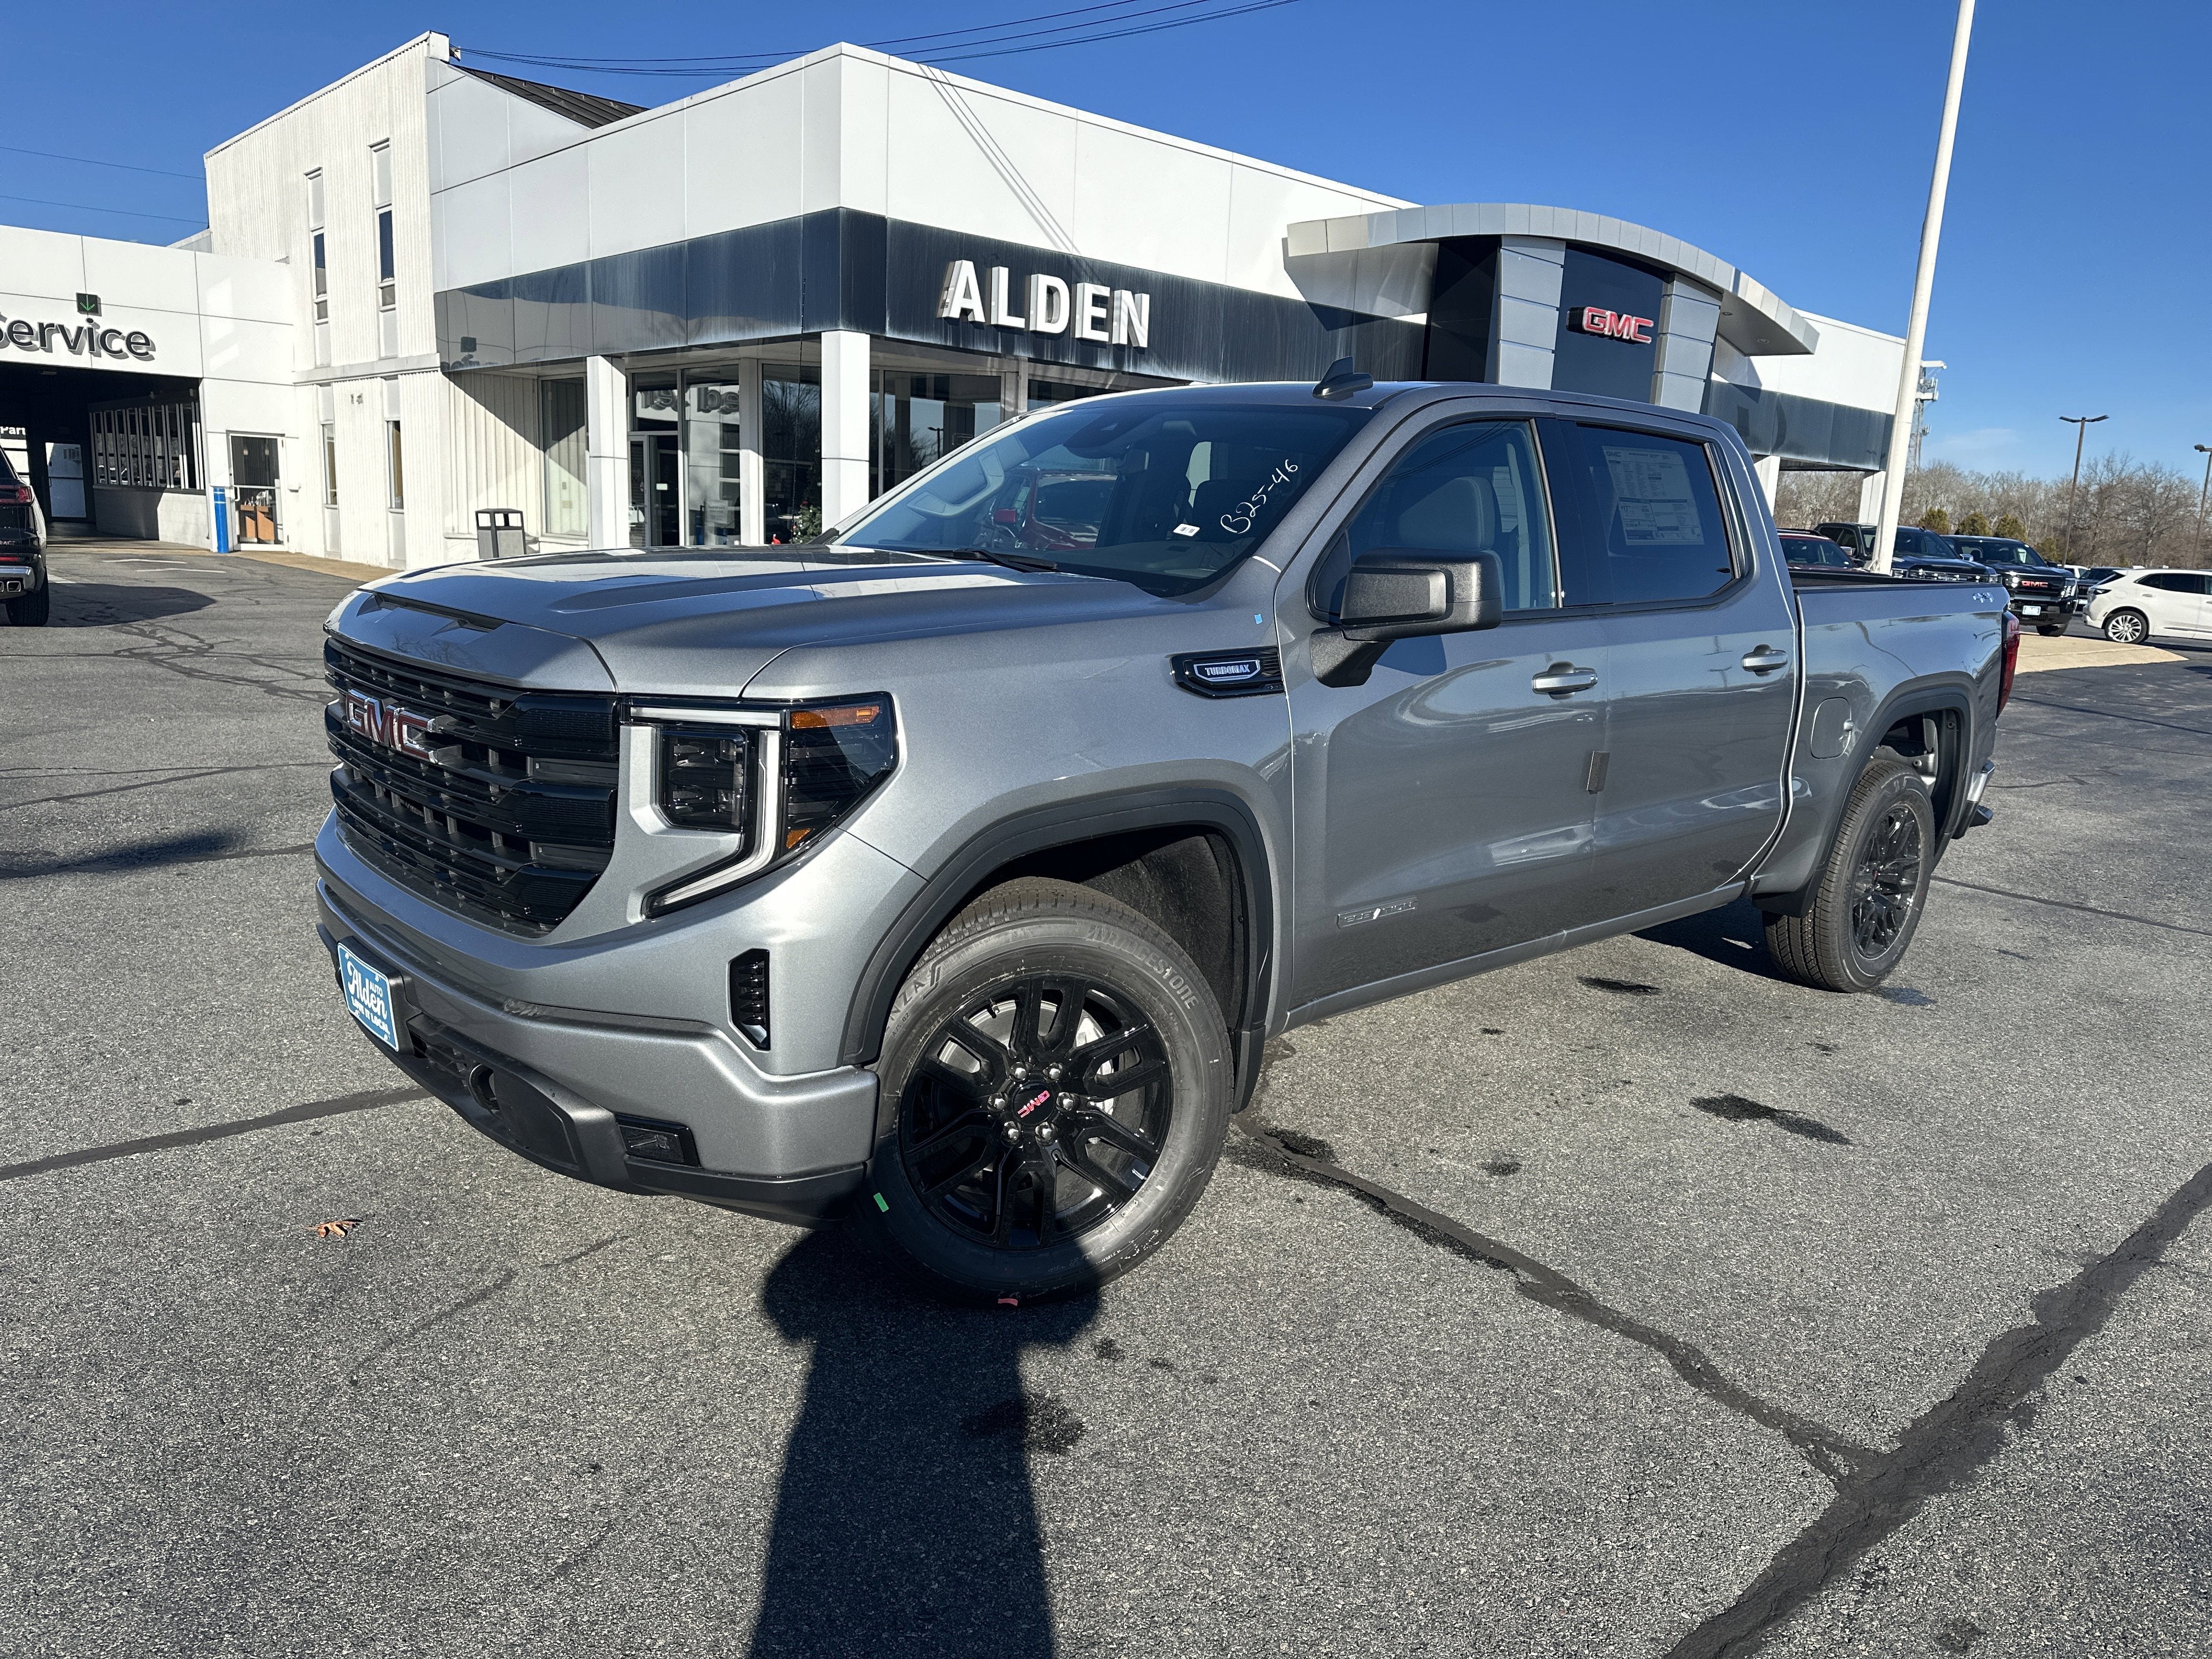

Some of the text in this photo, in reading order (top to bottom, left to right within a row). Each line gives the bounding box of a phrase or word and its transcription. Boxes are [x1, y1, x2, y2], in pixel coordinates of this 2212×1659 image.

[942, 259, 1150, 348] ALDEN
[0, 317, 151, 357] ervice
[1583, 306, 1655, 345] GMC
[1220, 459, 1298, 534] B25-46
[2021, 580, 2049, 588] GMC
[1205, 664, 1251, 676] TURBOMAX
[346, 689, 437, 764] GMC
[1344, 901, 1413, 923] ELETION
[1086, 924, 1199, 1011] BRIDGESTONE
[347, 961, 387, 1020] Alden
[370, 980, 383, 998] AUTO
[370, 1014, 391, 1035] LOCAL
[1017, 1090, 1050, 1119] GMC
